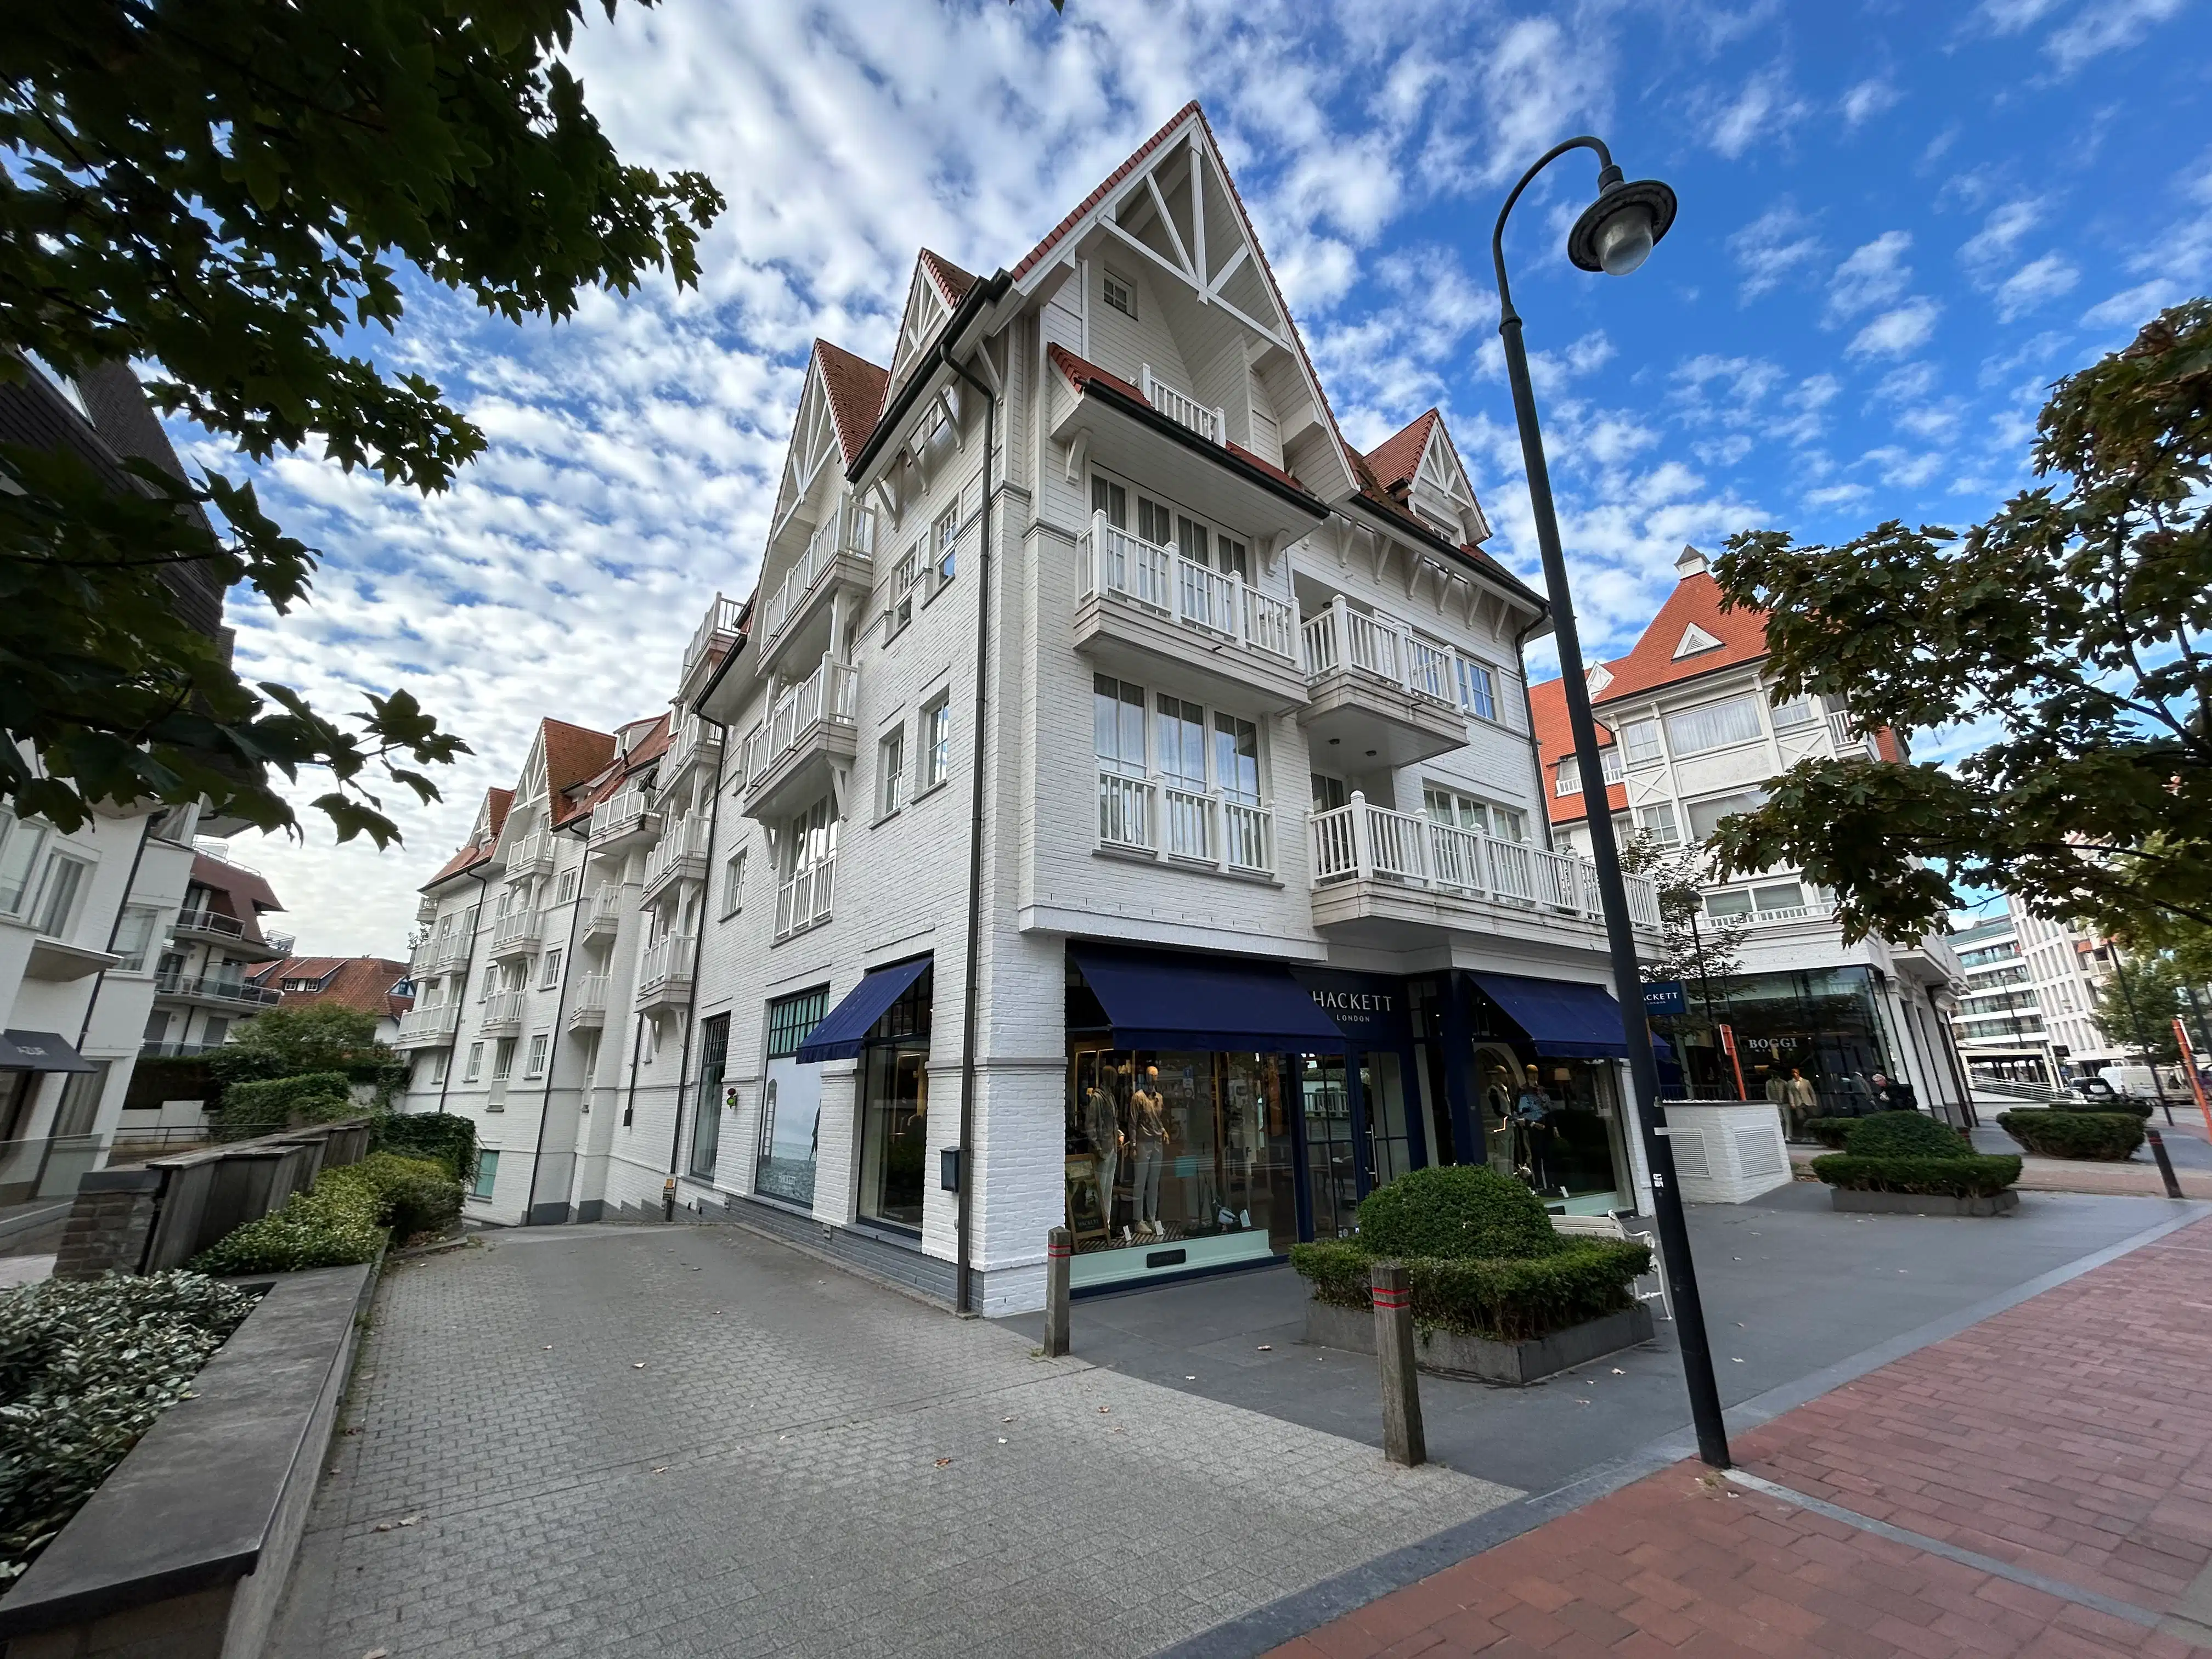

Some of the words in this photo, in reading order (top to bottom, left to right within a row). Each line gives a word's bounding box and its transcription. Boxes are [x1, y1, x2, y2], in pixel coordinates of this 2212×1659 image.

[1313, 990, 1392, 1012] HACKETT
[1644, 992, 1678, 1001] CKETT
[1336, 1014, 1370, 1023] LONDON
[1748, 1037, 1798, 1048] BOGGI
